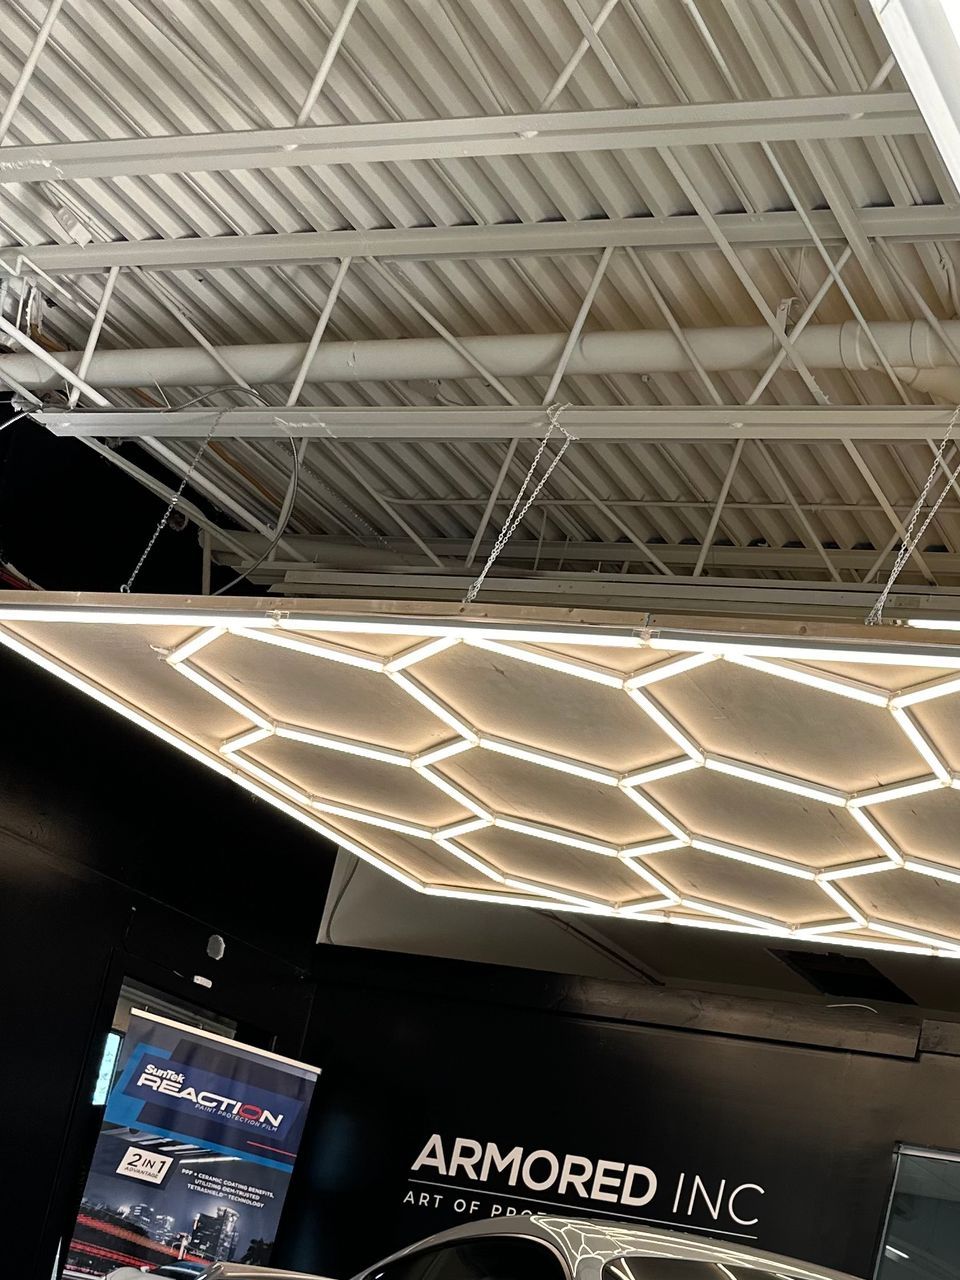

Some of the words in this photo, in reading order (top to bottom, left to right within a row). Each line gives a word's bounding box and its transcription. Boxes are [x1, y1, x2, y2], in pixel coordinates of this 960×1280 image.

[145, 1064, 186, 1083] SunTek
[136, 1073, 284, 1127] REACTION
[195, 1104, 217, 1113] PAINT
[217, 1110, 260, 1127] PROTECTION
[261, 1123, 278, 1132] FILM
[124, 1167, 159, 1178] ADVANTAGE
[127, 1153, 142, 1167] 2
[141, 1158, 157, 1169] IN
[157, 1160, 167, 1173] 1
[194, 1179, 222, 1190] UTILIZING
[198, 1173, 223, 1184] CERAMIC
[223, 1179, 248, 1191] COATING
[411, 1133, 658, 1207] ARMORED
[672, 1172, 766, 1226] INC
[228, 1194, 265, 1208] TECHNOLOGY
[403, 1190, 444, 1209] ART
[453, 1199, 481, 1214] OF
